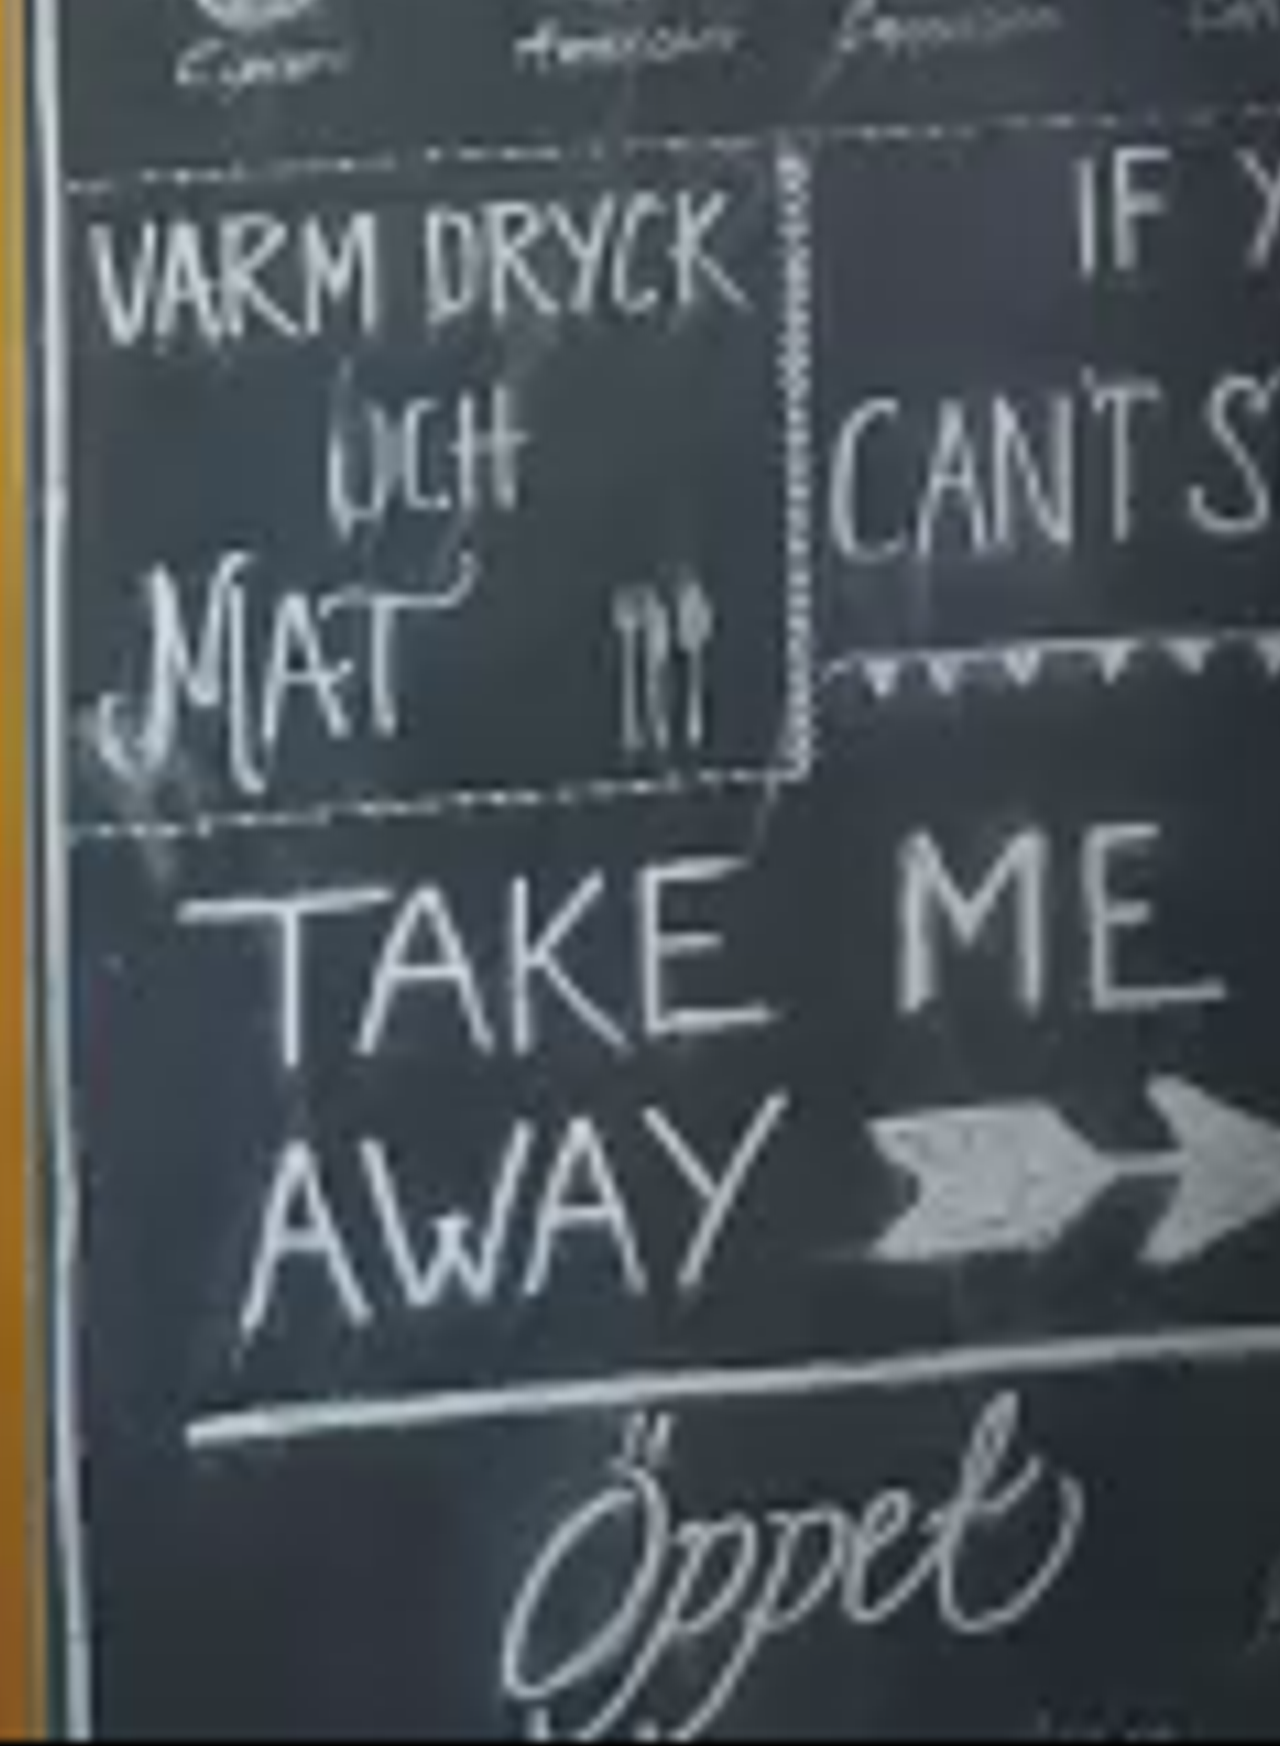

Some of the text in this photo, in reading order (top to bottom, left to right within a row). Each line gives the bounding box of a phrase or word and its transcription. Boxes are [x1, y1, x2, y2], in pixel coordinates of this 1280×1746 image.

[88, 189, 750, 349] VARM DRYCK
[1072, 149, 1175, 276] IF
[95, 544, 478, 794] MAT
[175, 819, 1225, 1069] TAKE ME
[230, 1089, 788, 1344] AWAY
[500, 1389, 1085, 1742] Öppet
